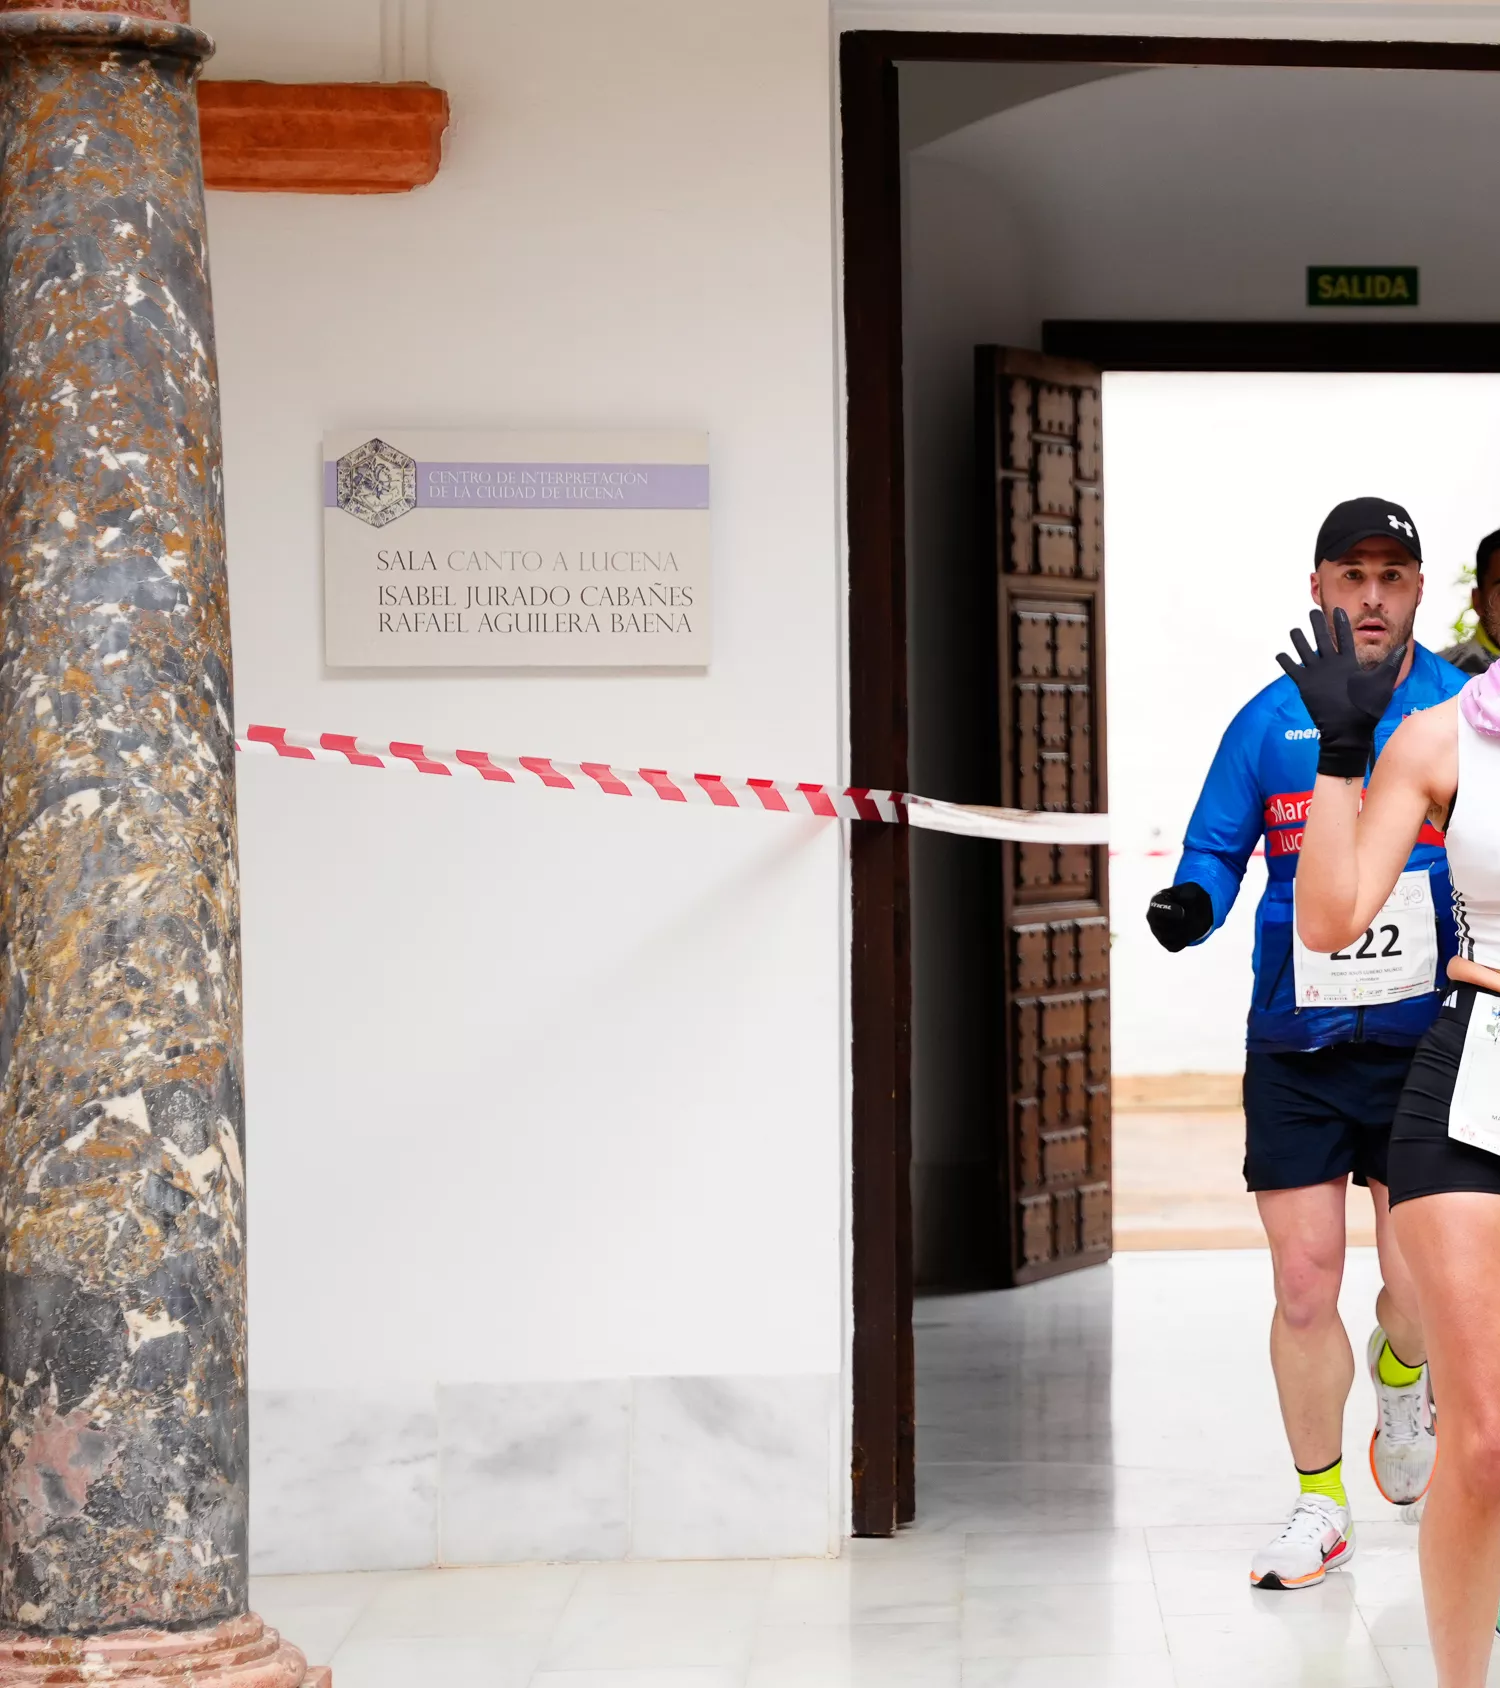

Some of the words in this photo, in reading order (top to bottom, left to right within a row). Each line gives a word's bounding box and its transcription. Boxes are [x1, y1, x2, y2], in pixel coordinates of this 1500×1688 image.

[1317, 273, 1410, 299] SALIDA
[429, 471, 491, 484] CENTRO
[497, 471, 516, 485] DE
[521, 469, 648, 485] INTERPRETACIÓN
[429, 486, 448, 498] DE
[454, 486, 471, 498] LA
[477, 486, 535, 499] CIUDAD
[541, 486, 560, 499] DE
[565, 487, 624, 500] LUCENA
[376, 550, 438, 572] SALA
[446, 550, 543, 572] CANTO
[552, 550, 569, 572] A
[578, 551, 679, 573] LUCENA
[378, 585, 457, 607] ISABEL
[464, 585, 571, 610] JURADO
[580, 582, 693, 608] CABAÑES
[378, 611, 469, 633] RAFAEL
[477, 611, 601, 633] AGUILERA
[610, 612, 693, 633] BAENA
